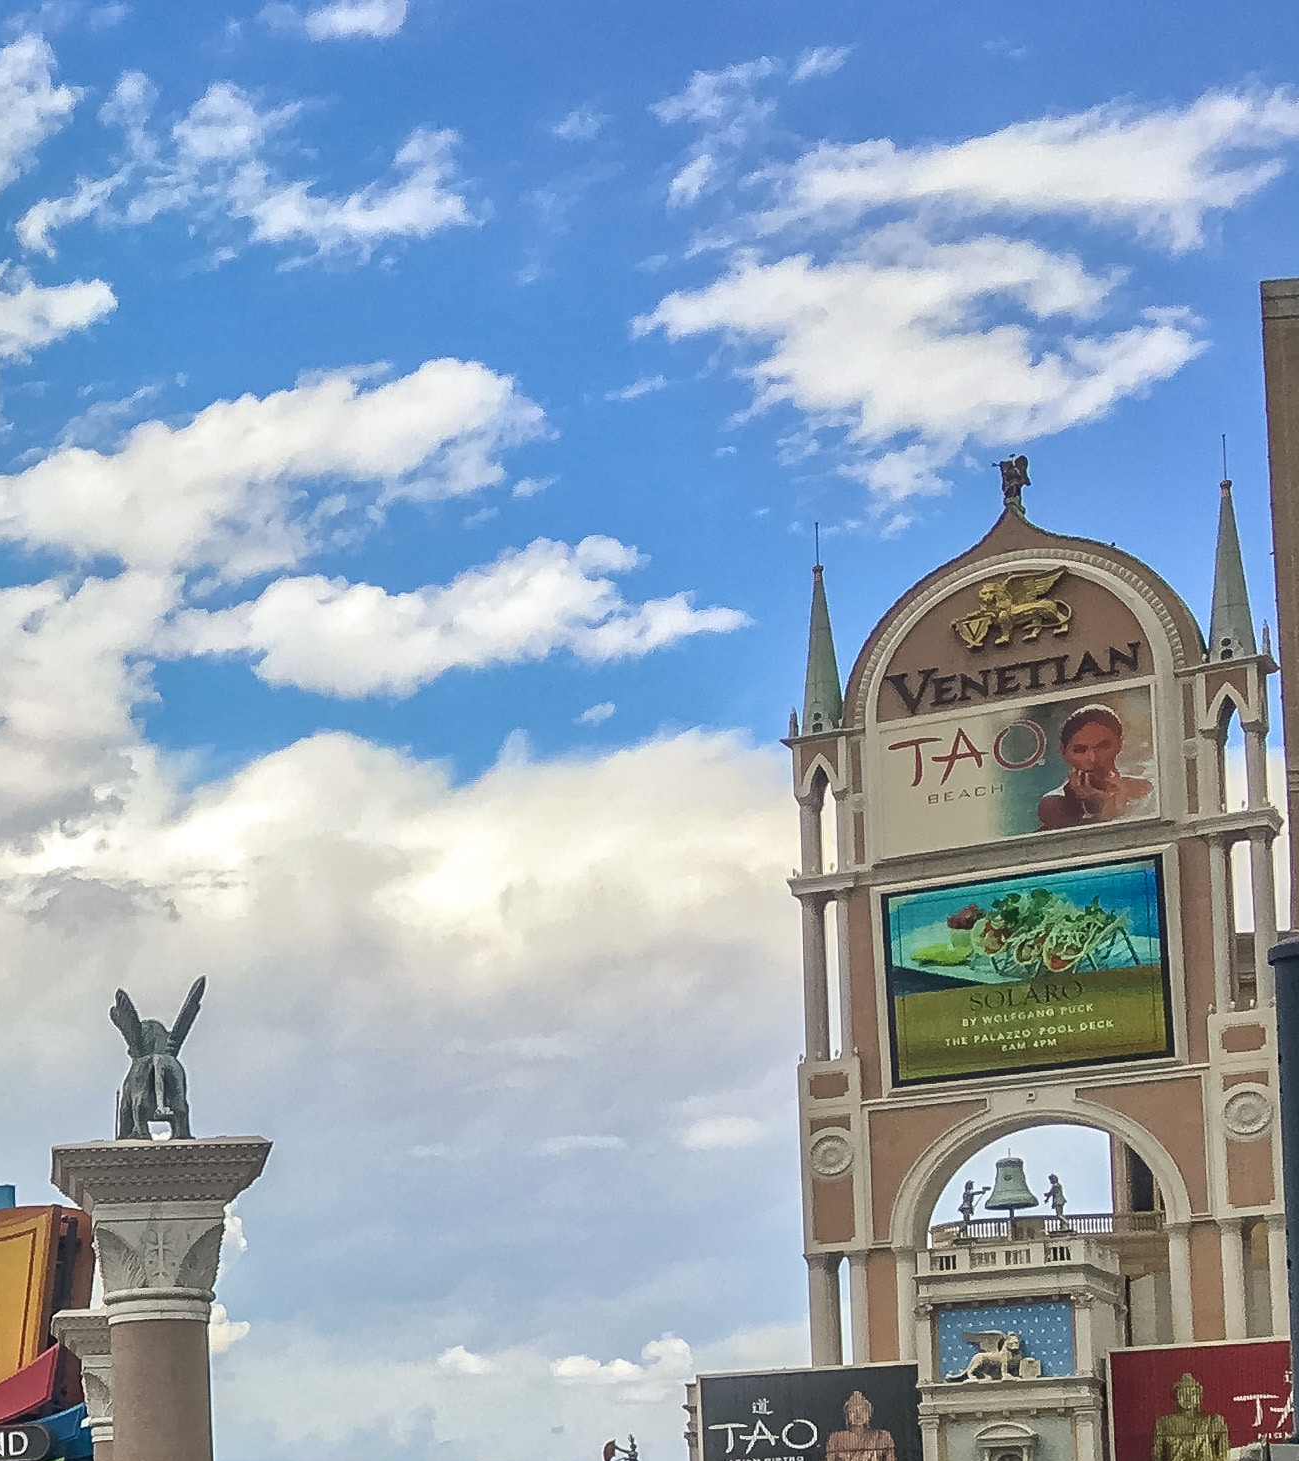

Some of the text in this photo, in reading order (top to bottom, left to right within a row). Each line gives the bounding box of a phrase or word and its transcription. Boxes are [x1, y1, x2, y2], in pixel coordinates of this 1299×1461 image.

[884, 641, 1142, 715] VENETIAN
[888, 718, 1046, 787] TAO
[927, 784, 1003, 805] BEACH
[969, 980, 1084, 1012] SOLARO
[962, 1003, 1095, 1027] BY WOLFGANG PUCK
[944, 1019, 1115, 1047] THE PALAZZO POOL DECK
[1033, 1038, 1057, 1049] 4PM
[1232, 1390, 1295, 1429] TA
[708, 1419, 818, 1454] TAO
